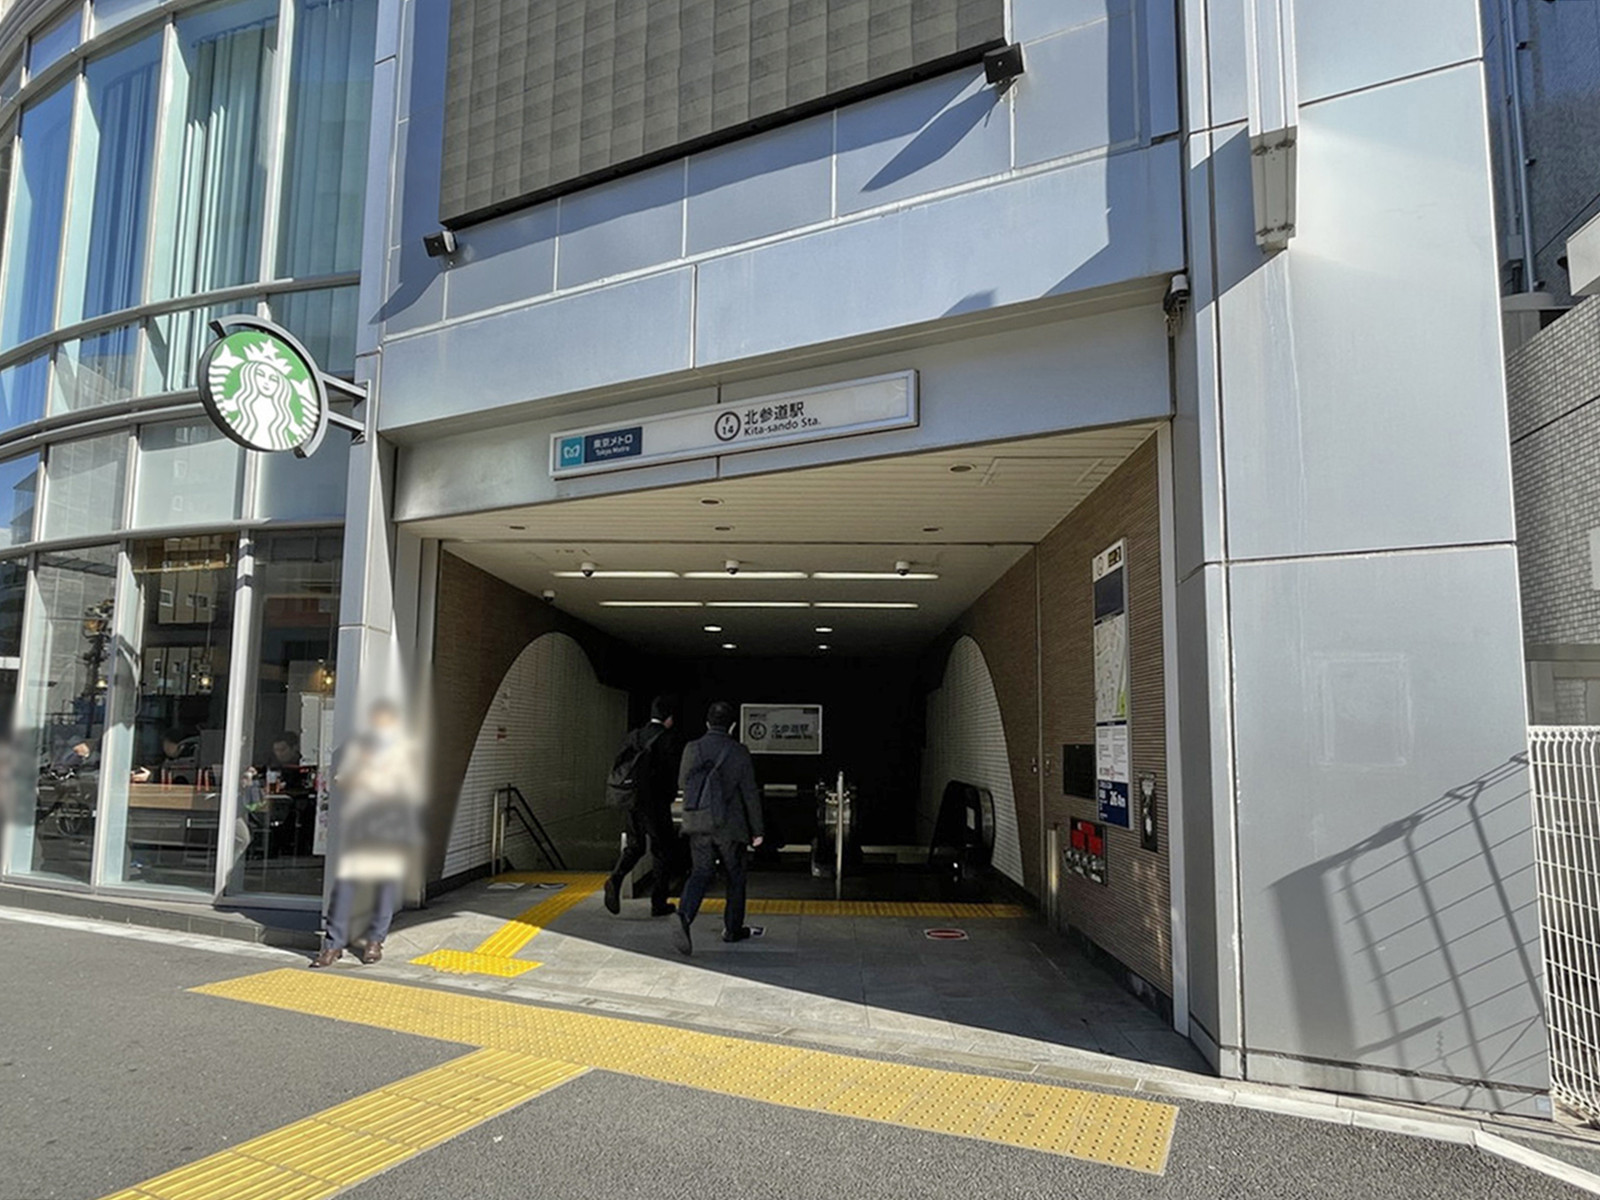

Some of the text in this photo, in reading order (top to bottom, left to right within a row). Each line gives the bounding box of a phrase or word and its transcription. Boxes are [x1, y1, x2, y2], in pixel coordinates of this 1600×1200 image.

[744, 401, 804, 426] 北参道駅
[722, 425, 734, 435] 14
[744, 417, 822, 437] Kita-sando Sta.
